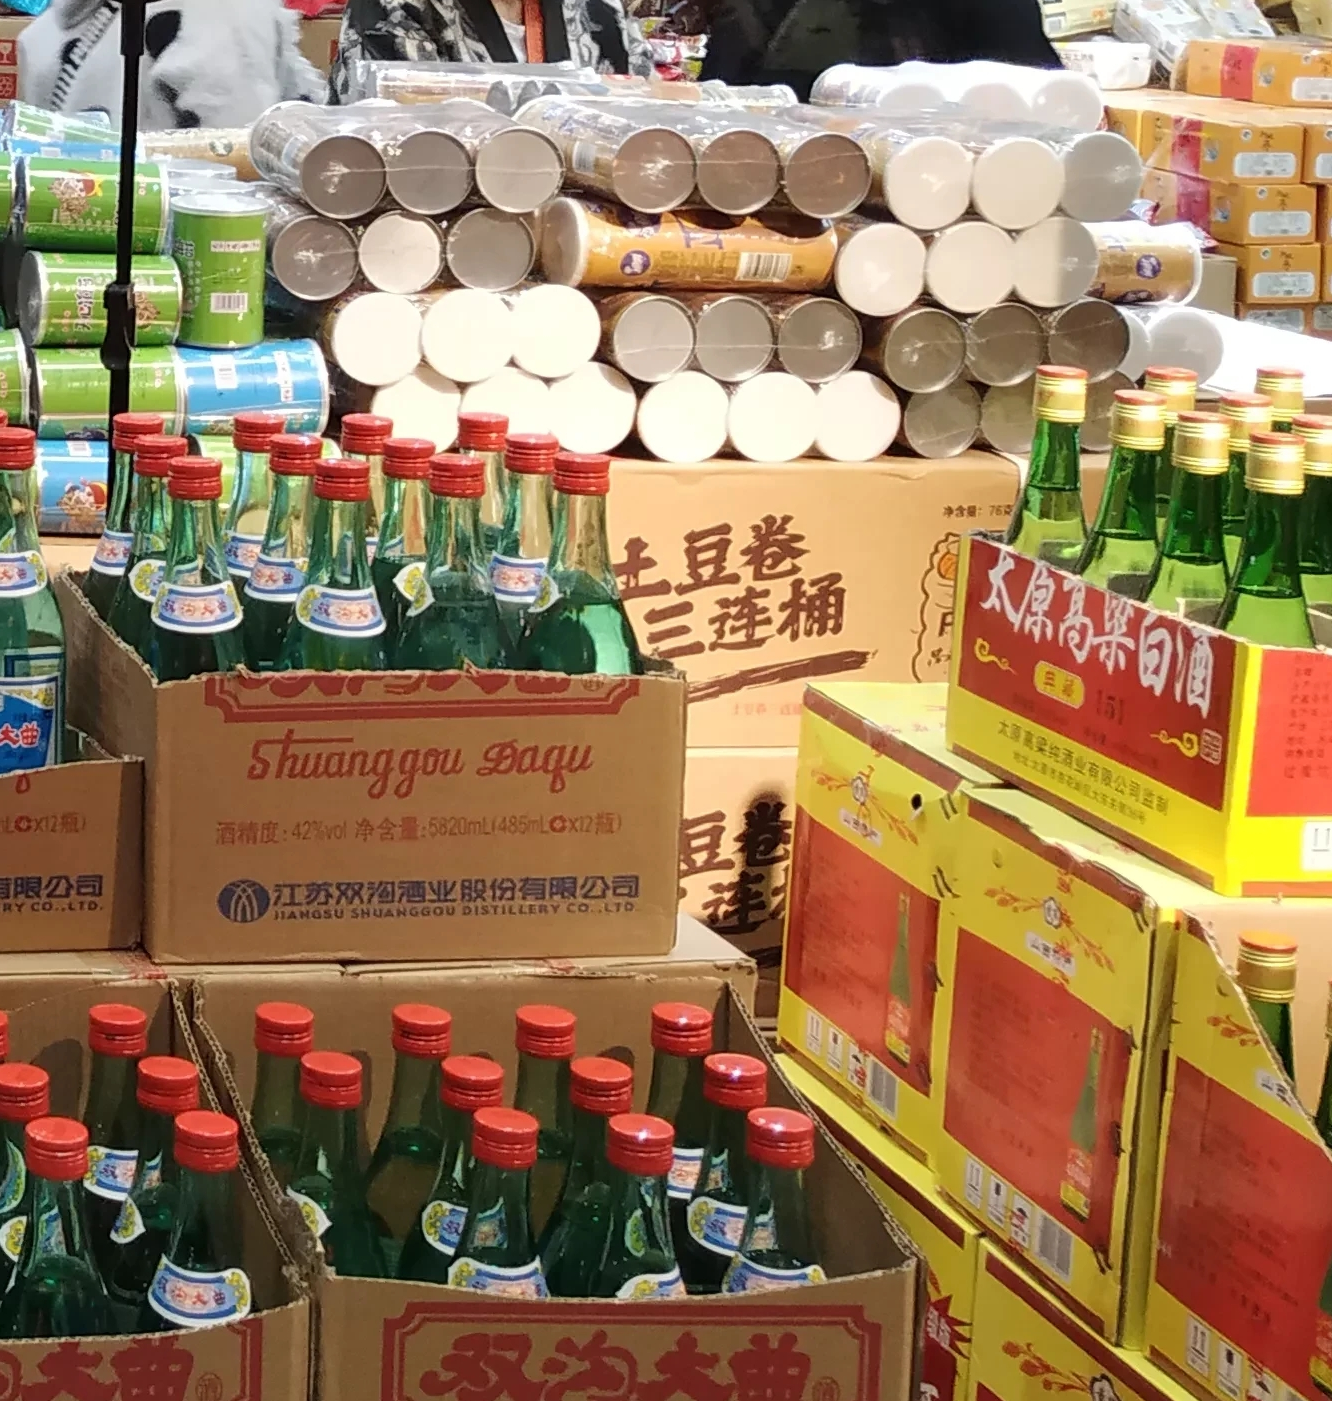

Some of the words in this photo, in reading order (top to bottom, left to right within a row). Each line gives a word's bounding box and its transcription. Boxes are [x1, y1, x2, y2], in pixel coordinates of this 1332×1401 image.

[611, 513, 812, 601] 土豆卷
[642, 570, 847, 659] 三连桶
[245, 728, 465, 801] Shuanggou
[273, 874, 640, 908] 江苏双沟酒业股份有限公司
[273, 907, 347, 921] JIANGSU
[350, 905, 458, 920] SHUANGGOU
[461, 903, 560, 917] DISTILLERY
[421, 1329, 811, 1401] 双沟大曲
